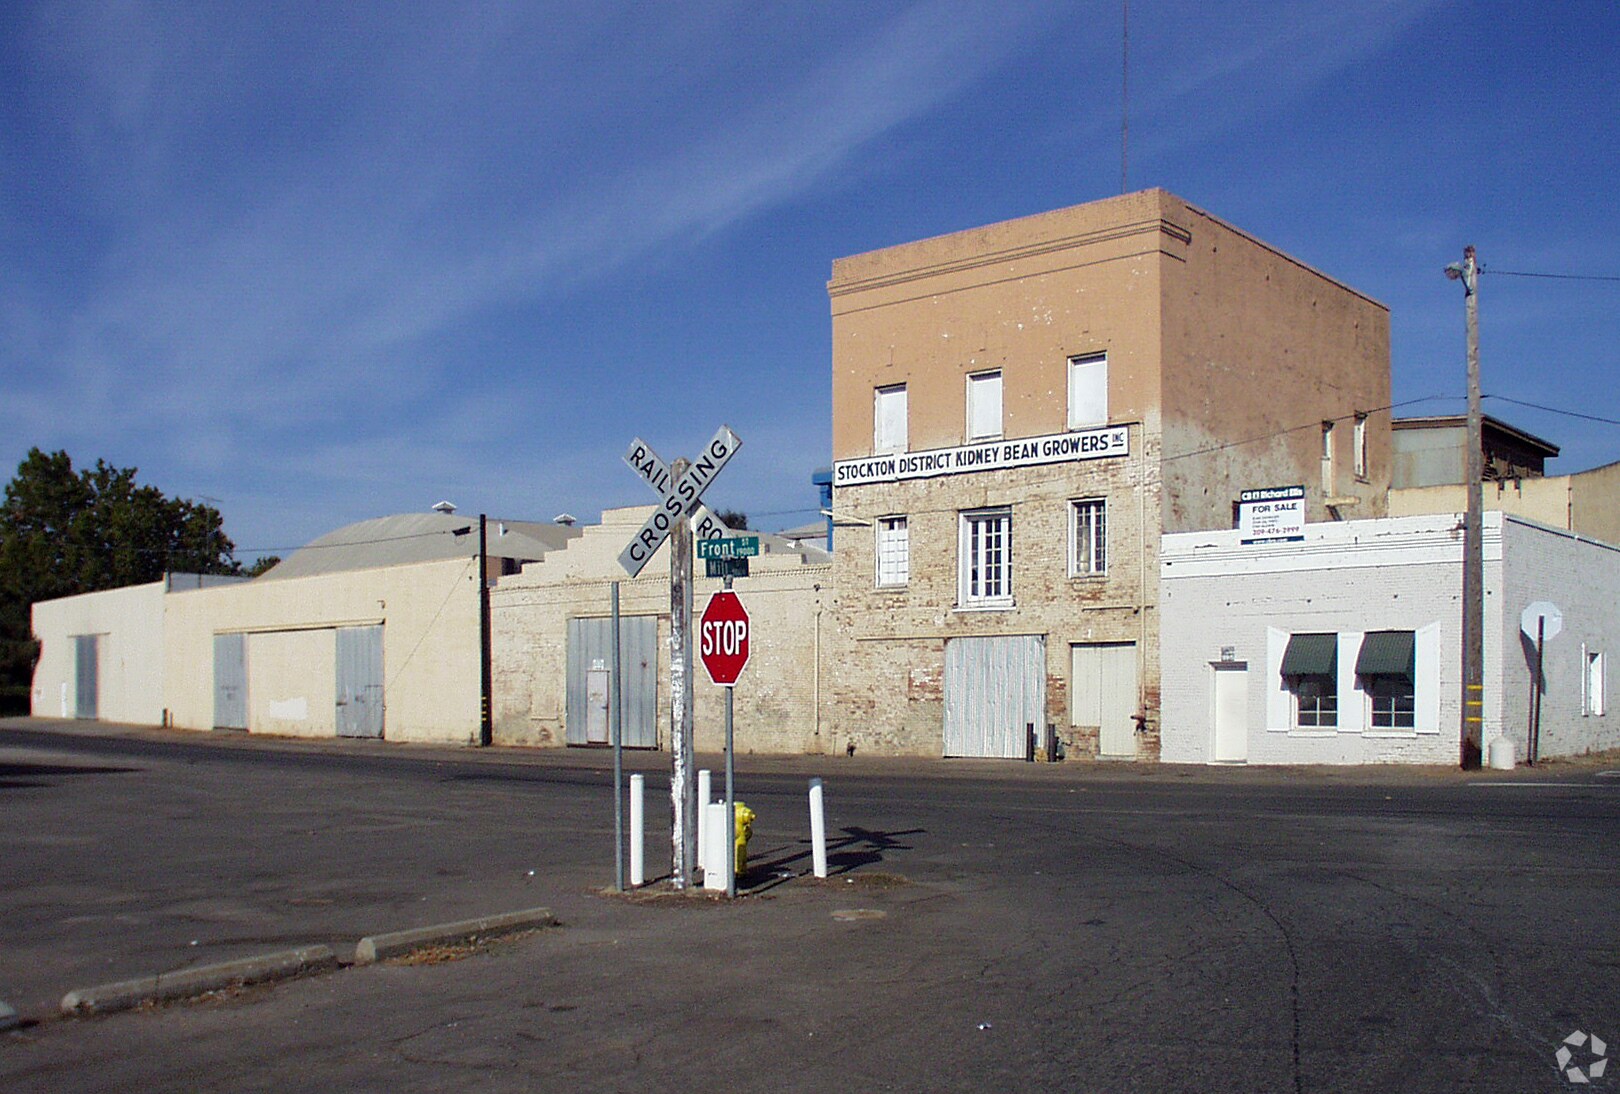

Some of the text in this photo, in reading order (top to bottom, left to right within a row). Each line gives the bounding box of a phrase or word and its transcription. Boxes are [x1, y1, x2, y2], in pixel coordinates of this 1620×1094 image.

[629, 446, 669, 494] RAIL
[837, 432, 1124, 481] STOCKTON DISTRICT KIDNEY BEAN GROWERS INC
[630, 440, 728, 562] CROSSING
[1252, 502, 1297, 514] FOR SALE
[1260, 489, 1289, 500] Richard
[697, 517, 723, 540] RO
[701, 540, 735, 556] Front
[702, 620, 747, 657] STOP
